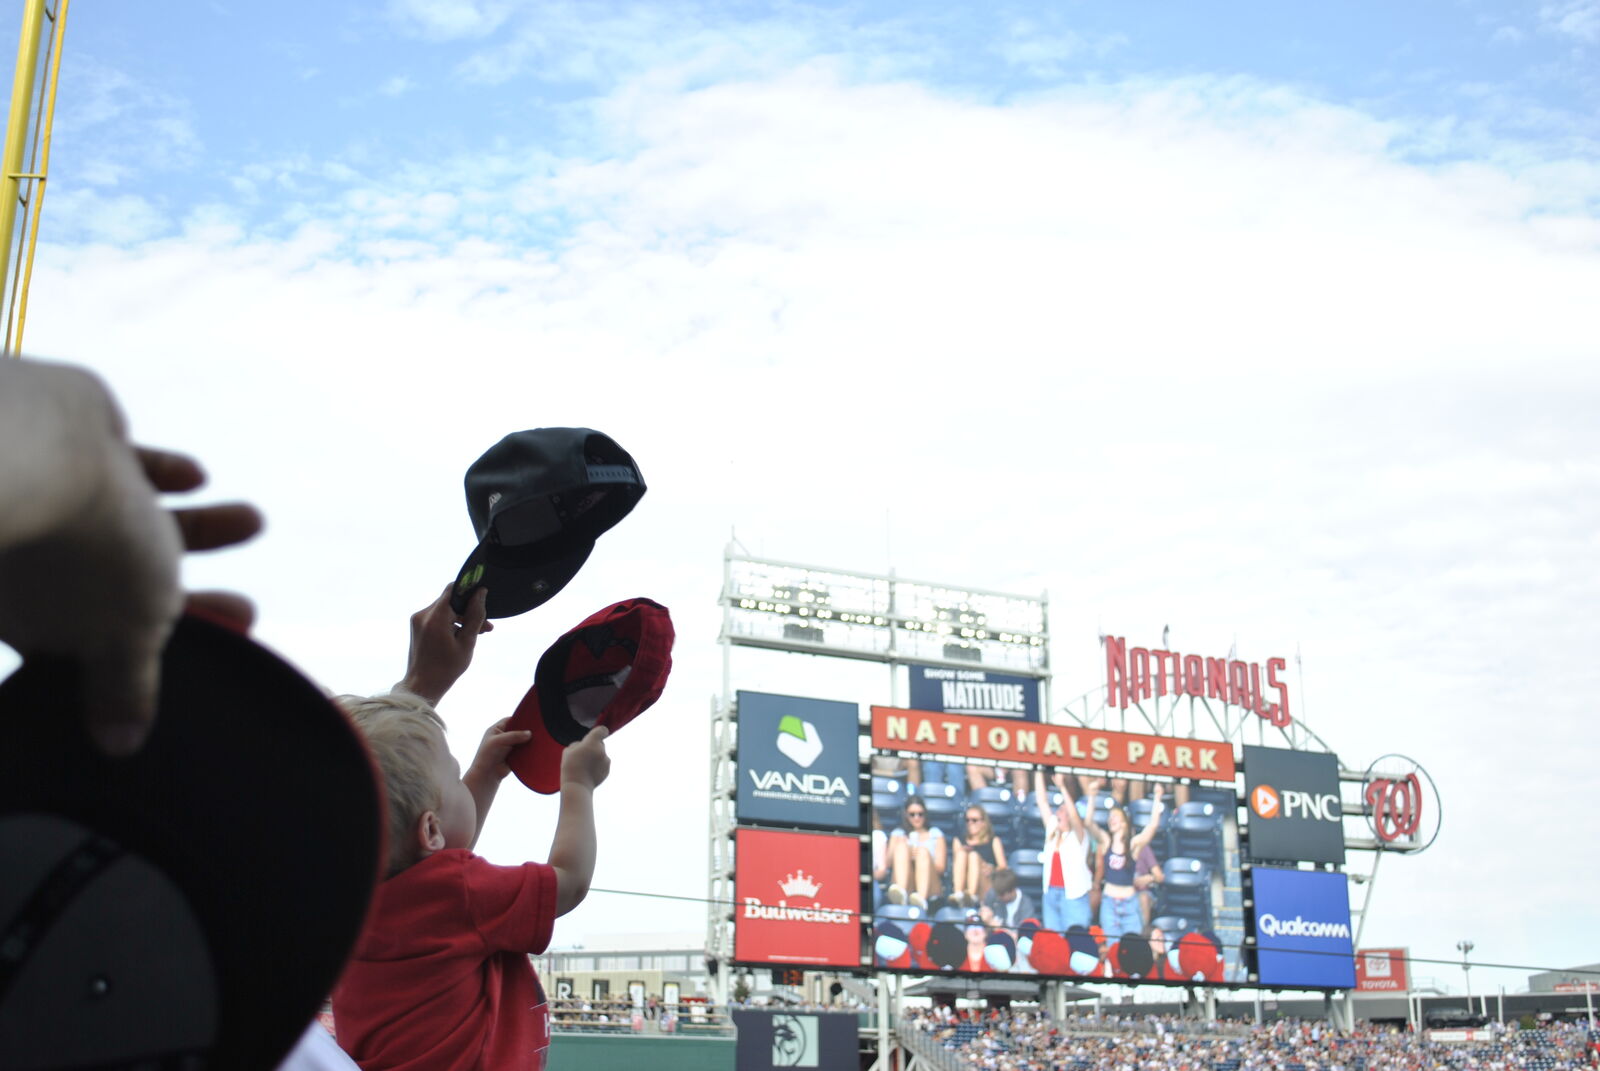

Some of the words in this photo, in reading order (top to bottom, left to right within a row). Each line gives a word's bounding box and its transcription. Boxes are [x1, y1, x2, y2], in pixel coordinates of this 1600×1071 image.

[1105, 634, 1292, 728] NATIONALS
[942, 681, 1025, 711] NATITUDE
[886, 715, 1109, 762] NATIONALS
[1127, 738, 1218, 772] PARK
[748, 769, 851, 797] VANDA
[1281, 790, 1341, 822] PNC
[743, 897, 854, 924] Budweiser
[1259, 913, 1350, 938] Qualcomm
[1361, 980, 1398, 989] TOYOTA
